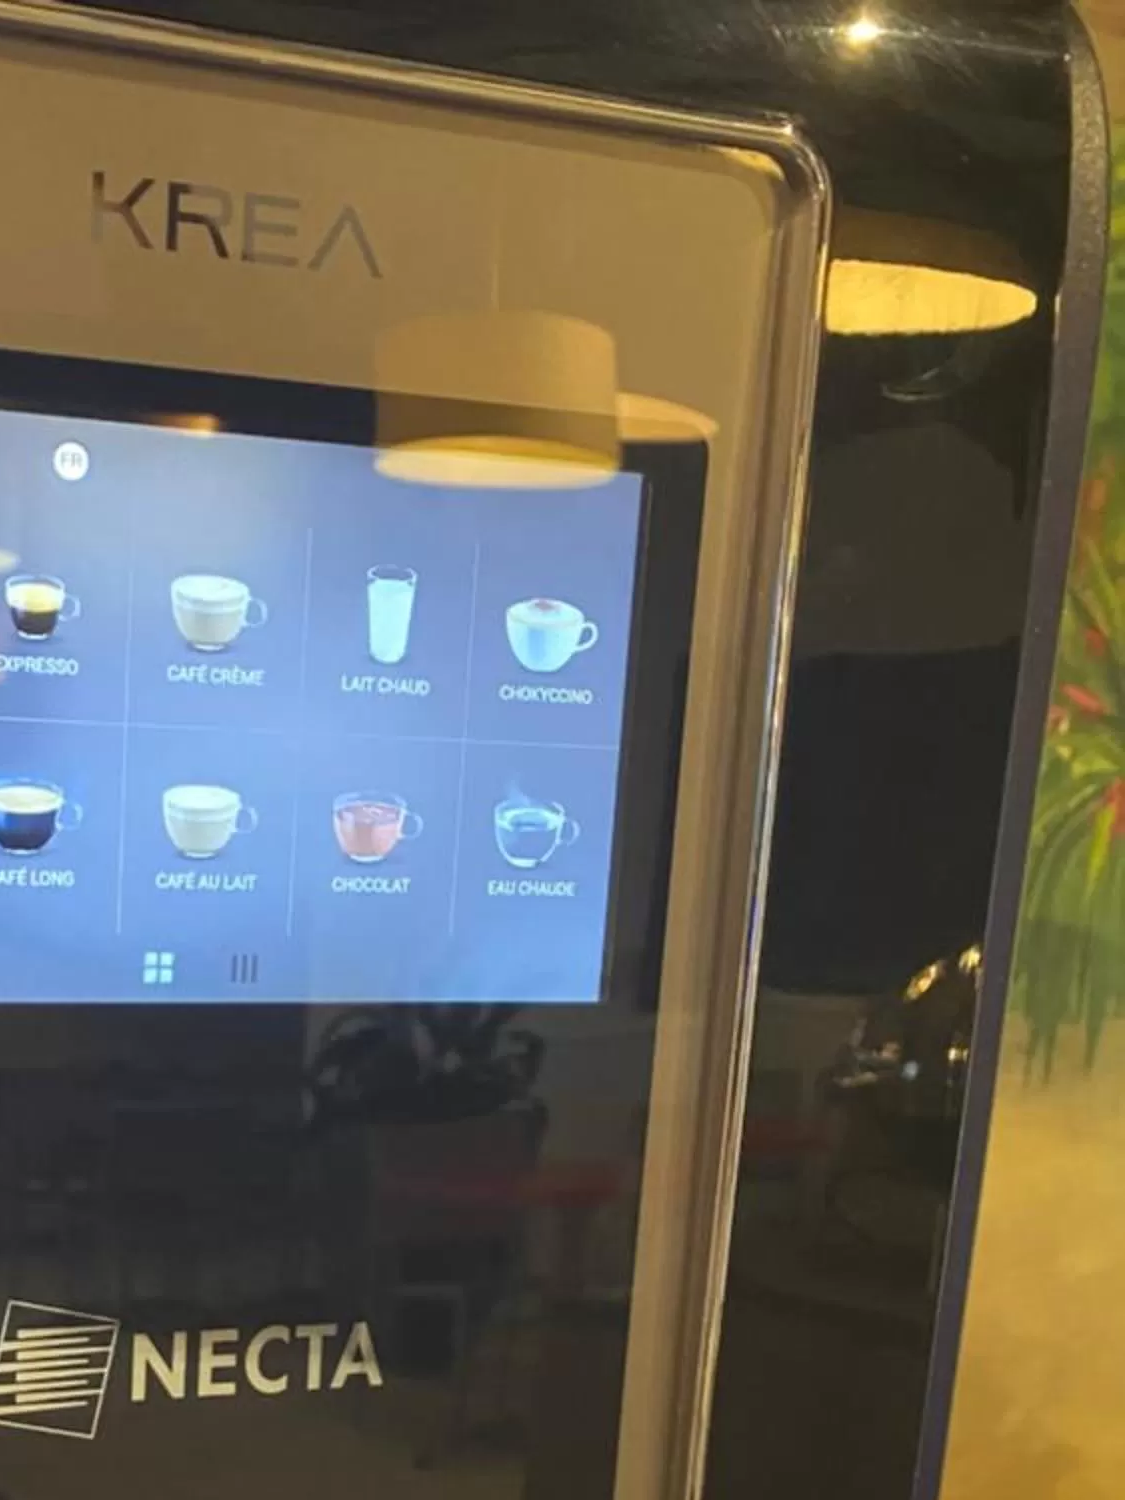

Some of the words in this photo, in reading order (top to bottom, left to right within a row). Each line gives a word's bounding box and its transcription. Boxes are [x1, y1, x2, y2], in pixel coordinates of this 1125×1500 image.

[90, 169, 383, 280] KREA
[60, 452, 83, 469] FR
[167, 663, 208, 684] CAFÉ
[211, 665, 264, 687] CRÈME
[341, 676, 374, 693] LAIT
[377, 677, 430, 696] CHAUD
[30, 870, 75, 887] LONG
[156, 869, 196, 889] CAFÉ
[199, 873, 222, 891] AU
[225, 874, 257, 891] LAIT
[332, 876, 411, 894] CHOCOLAT
[488, 879, 516, 896] EAU
[518, 880, 576, 898] CHAUDE
[131, 1321, 383, 1401] NECTA
